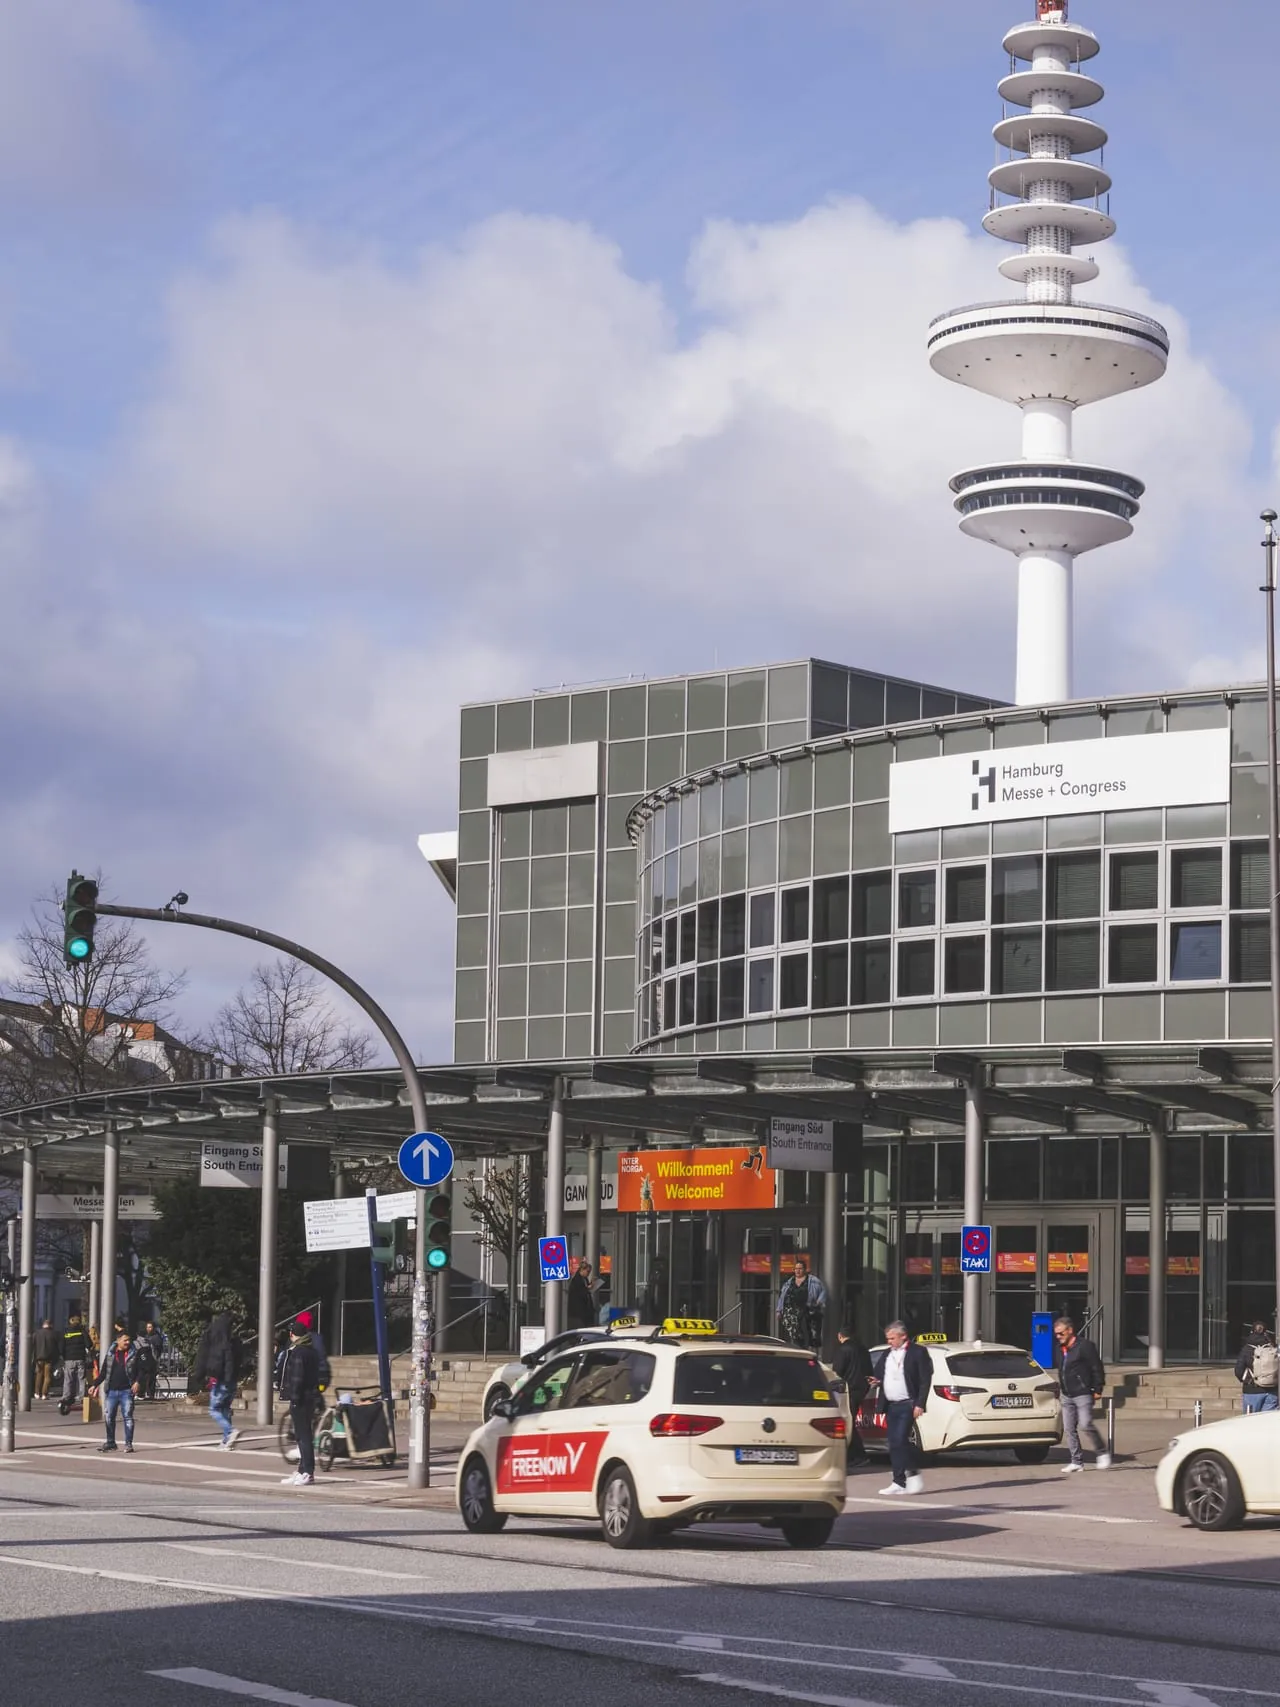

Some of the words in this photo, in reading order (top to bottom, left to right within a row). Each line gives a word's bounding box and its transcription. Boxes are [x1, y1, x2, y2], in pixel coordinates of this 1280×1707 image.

[1002, 762, 1063, 780] Hamburg
[1002, 787, 1044, 802] Messe
[1060, 780, 1127, 797] Congress
[772, 1119, 806, 1135] Eingang
[807, 1121, 823, 1134] Süd
[204, 1144, 249, 1157] Eingang
[772, 1136, 796, 1148] South
[798, 1137, 832, 1151] Entrance
[203, 1160, 236, 1170] South
[238, 1161, 286, 1172] Entre
[621, 1157, 640, 1165] INTER
[657, 1159, 734, 1177] Willkommen!
[621, 1165, 643, 1173] NORGA
[665, 1182, 724, 1199] Welcome!
[964, 1258, 988, 1269] TAXI
[544, 1265, 567, 1278] TAXI
[676, 1319, 713, 1330] TAXI
[512, 1455, 568, 1477] FREENOW
